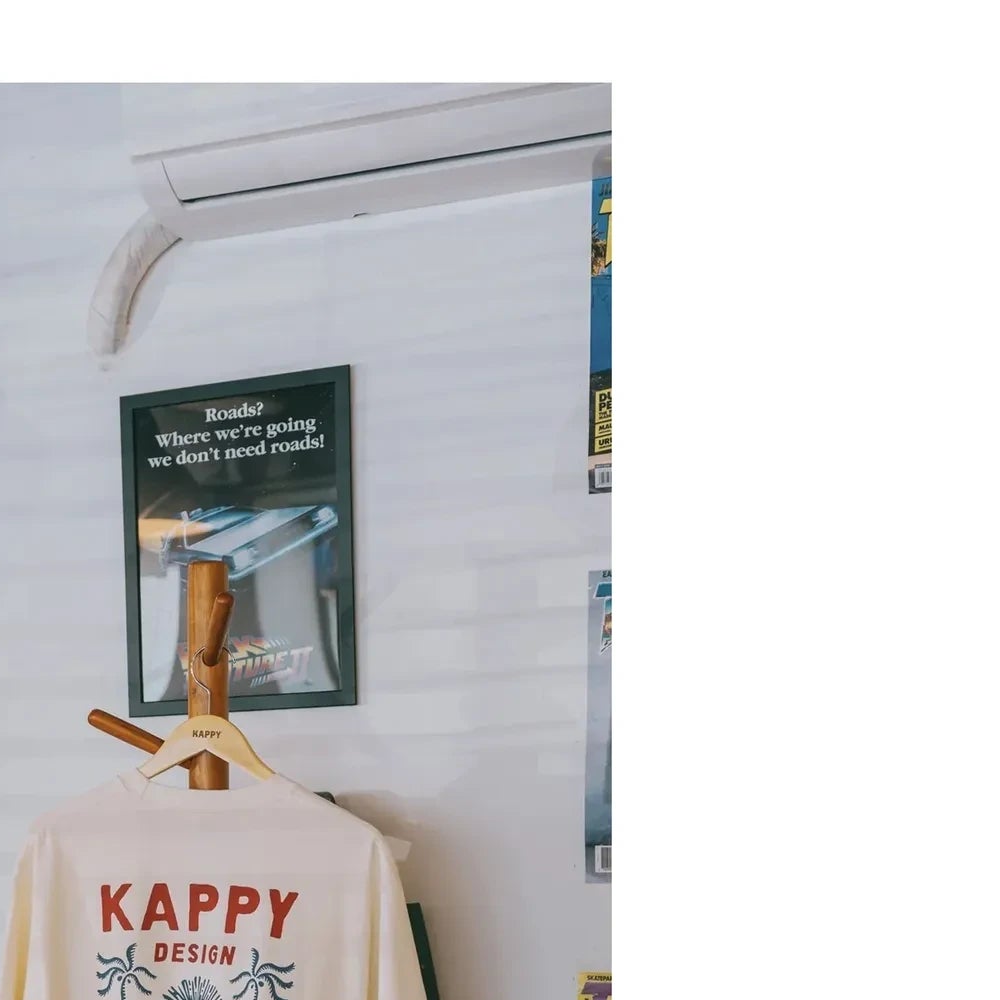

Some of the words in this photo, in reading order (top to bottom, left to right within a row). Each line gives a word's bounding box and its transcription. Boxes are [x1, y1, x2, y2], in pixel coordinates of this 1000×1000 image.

[205, 402, 264, 423] Roads?
[155, 430, 211, 449] Where
[215, 424, 262, 441] we're
[266, 417, 316, 438] going
[147, 454, 172, 468] we
[176, 447, 220, 465] don't
[225, 440, 266, 460] need
[270, 434, 325, 453] roads!
[192, 729, 222, 739] KAPPY
[100, 883, 299, 939] KAPPY
[154, 942, 236, 966] DESIGN
